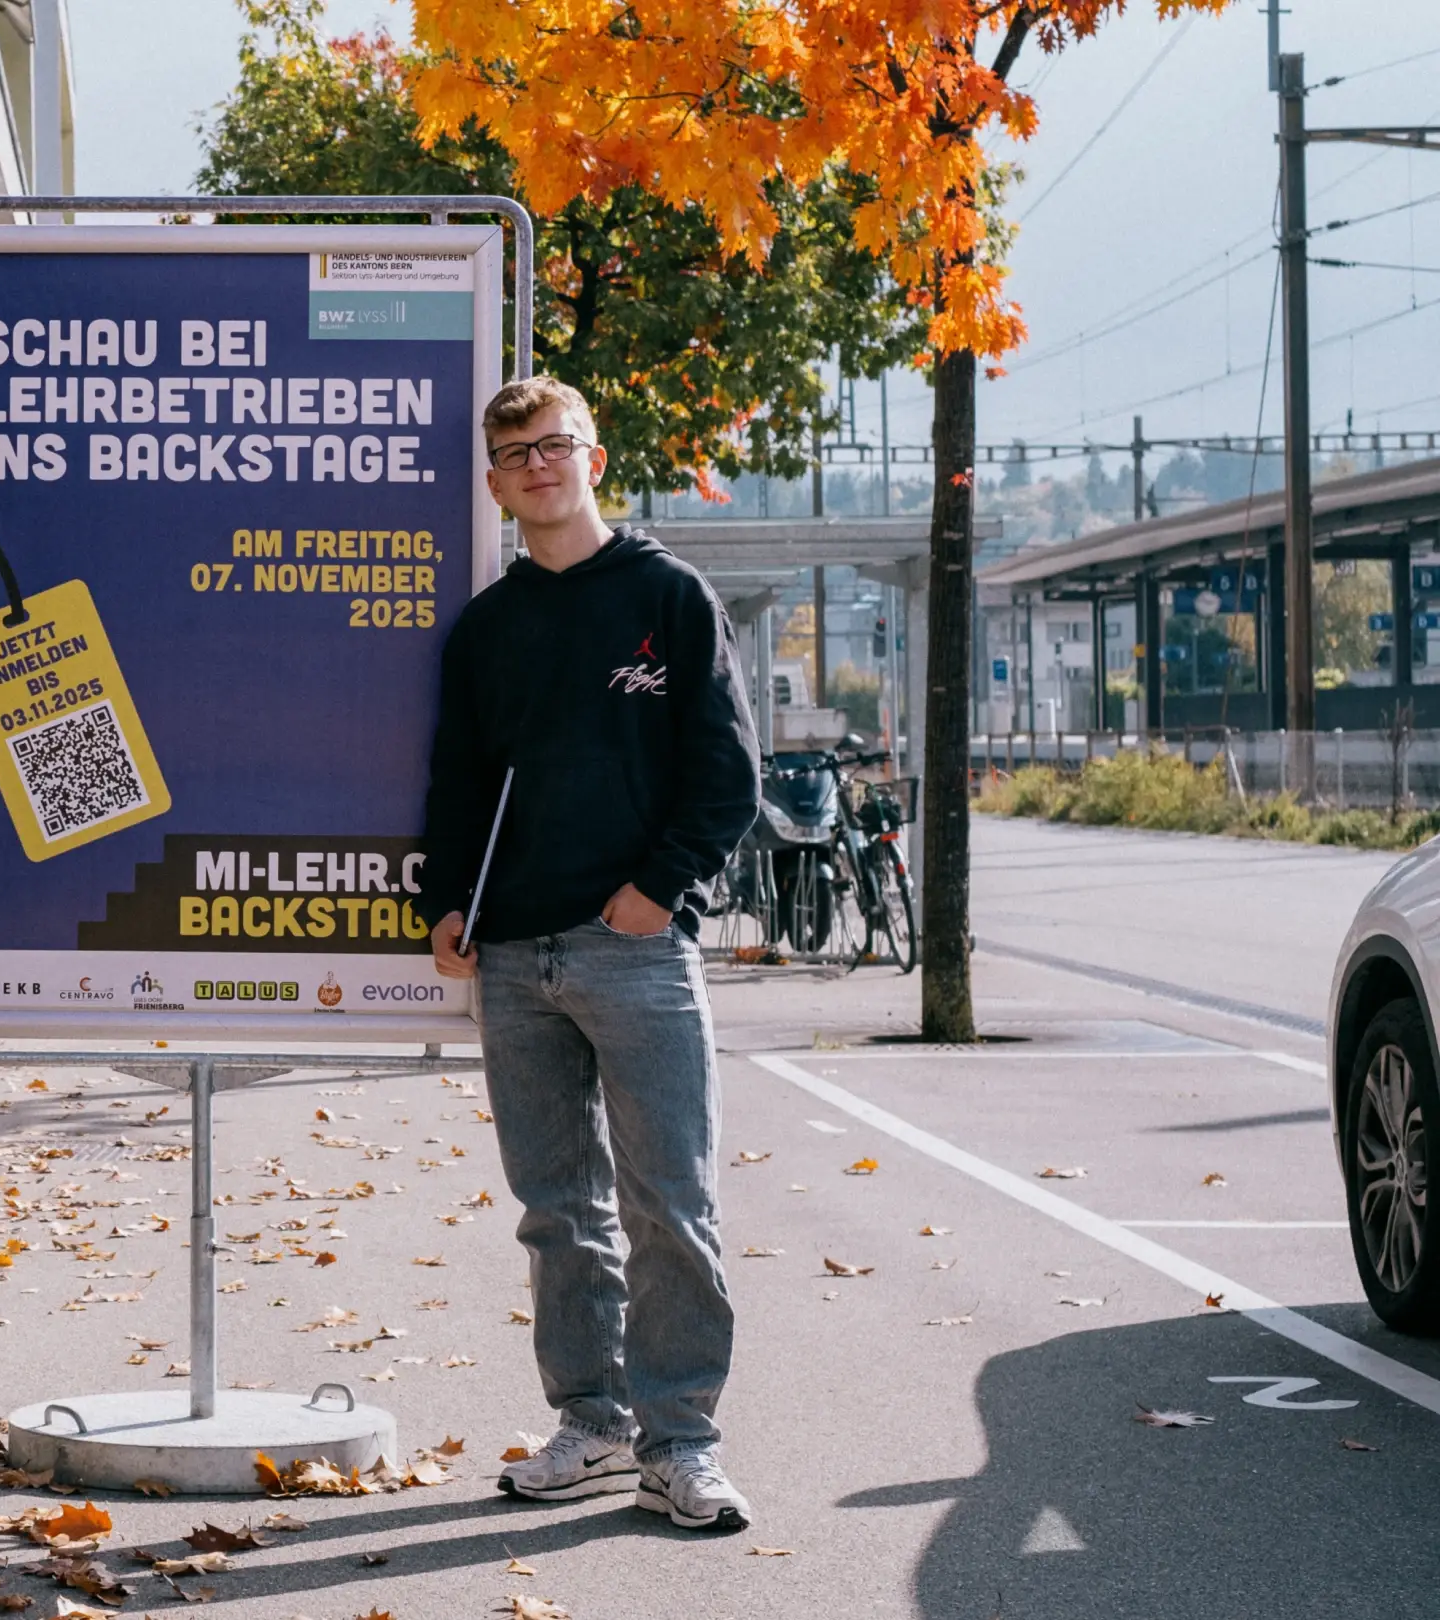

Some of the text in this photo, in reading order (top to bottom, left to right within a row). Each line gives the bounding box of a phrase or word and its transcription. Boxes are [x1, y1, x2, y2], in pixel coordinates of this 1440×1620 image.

[332, 262, 413, 270] DES KANTONS BERN
[395, 254, 467, 262] INDUSTRIEVEREIN
[332, 272, 358, 280] Sektion
[404, 272, 418, 280] und
[419, 272, 459, 281] Umgebung
[319, 310, 387, 323] BWZ LYSS
[180, 319, 267, 367] BEI
[89, 433, 435, 483] BACKSTAGE.
[232, 529, 443, 563] AM FREITAG,
[190, 563, 436, 593] 07. NOVEMBER
[349, 599, 436, 628] 2025
[26, 671, 60, 697] BIS
[0, 678, 104, 732] 03.11.2025
[195, 850, 427, 893] MI-LEHR.C
[179, 896, 430, 940] BACKSTAG
[197, 983, 297, 999] TALUS
[362, 983, 444, 1002] evolon
